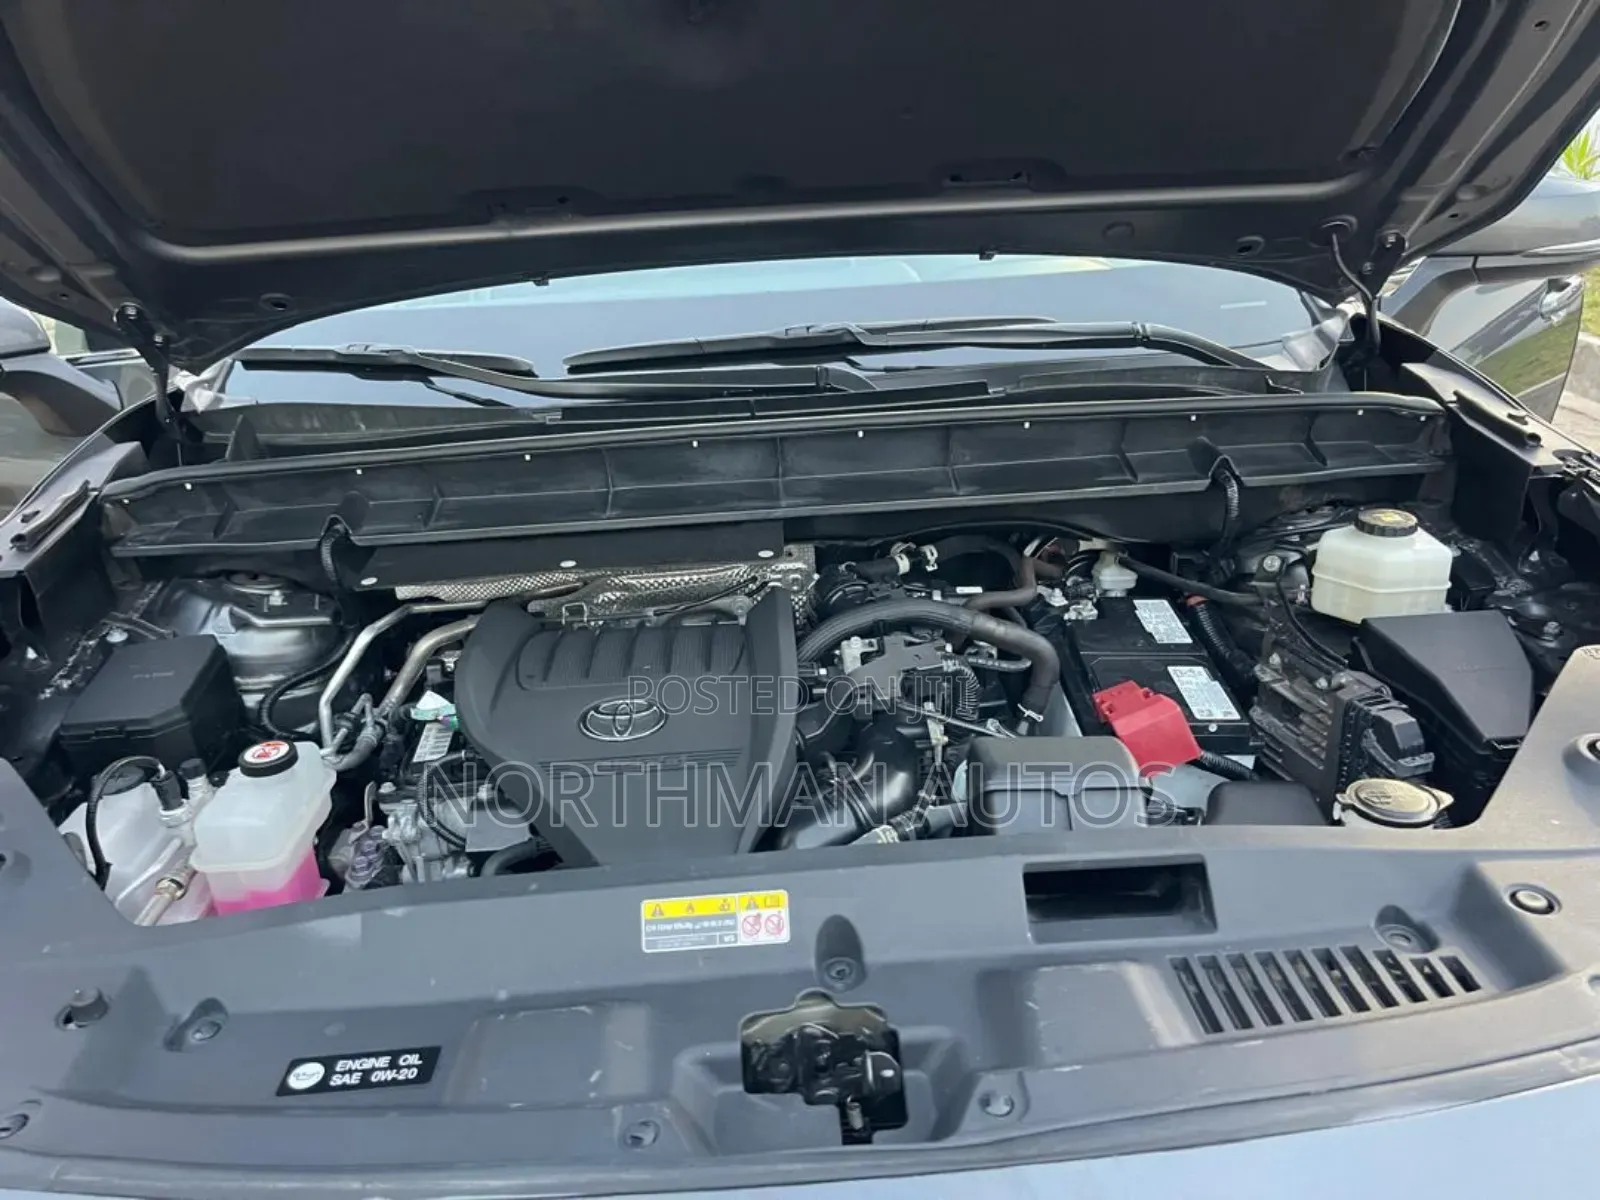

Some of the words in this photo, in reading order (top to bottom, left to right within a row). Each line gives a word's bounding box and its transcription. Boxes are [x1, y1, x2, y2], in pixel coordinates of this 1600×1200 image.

[335, 1056, 391, 1072] ENGINE
[399, 1053, 423, 1066] OIL
[329, 1072, 363, 1086] SAE
[371, 1067, 418, 1083] 0W-20
